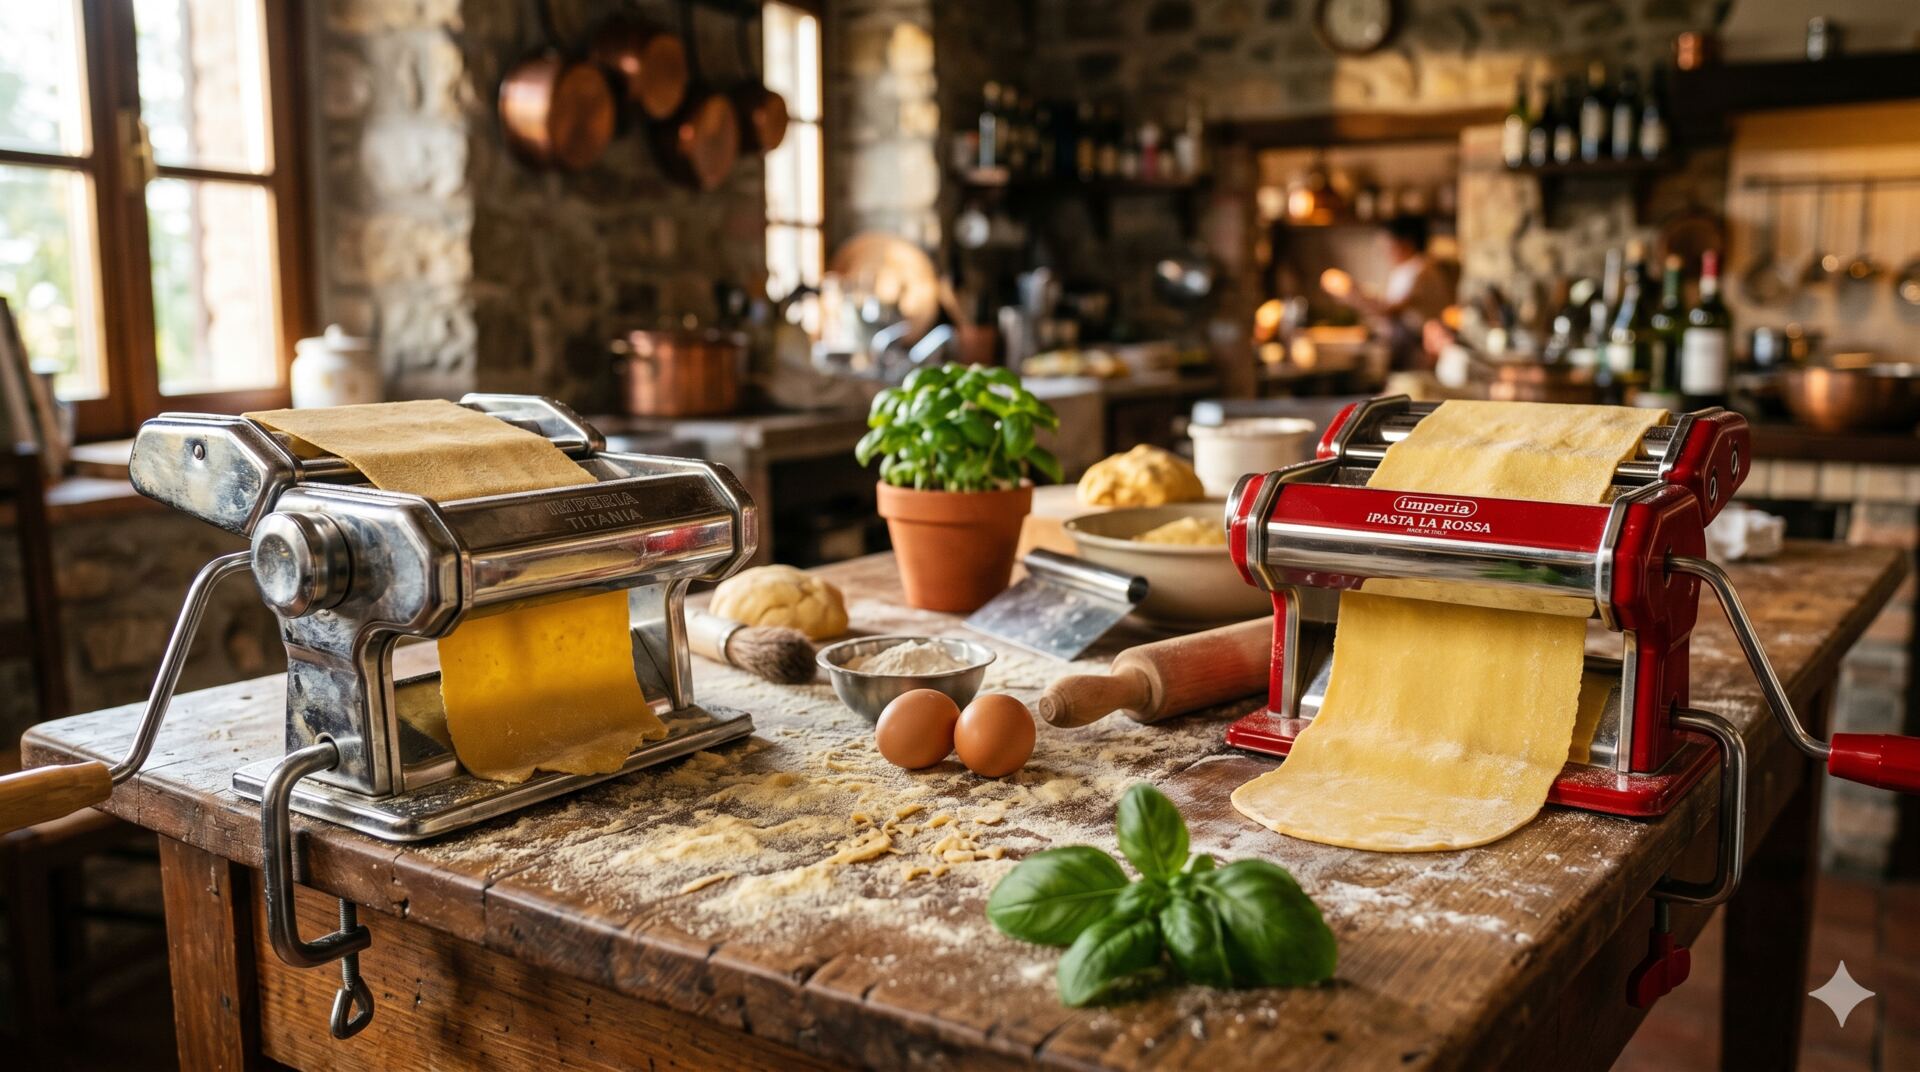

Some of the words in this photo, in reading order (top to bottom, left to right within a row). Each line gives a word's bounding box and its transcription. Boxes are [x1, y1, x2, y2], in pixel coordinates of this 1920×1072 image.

[545, 491, 639, 515] IMPERIA
[1399, 497, 1470, 514] imperia
[565, 508, 643, 529] TITANIA
[1418, 517, 1437, 529] LA
[1442, 519, 1491, 533] ROSSA
